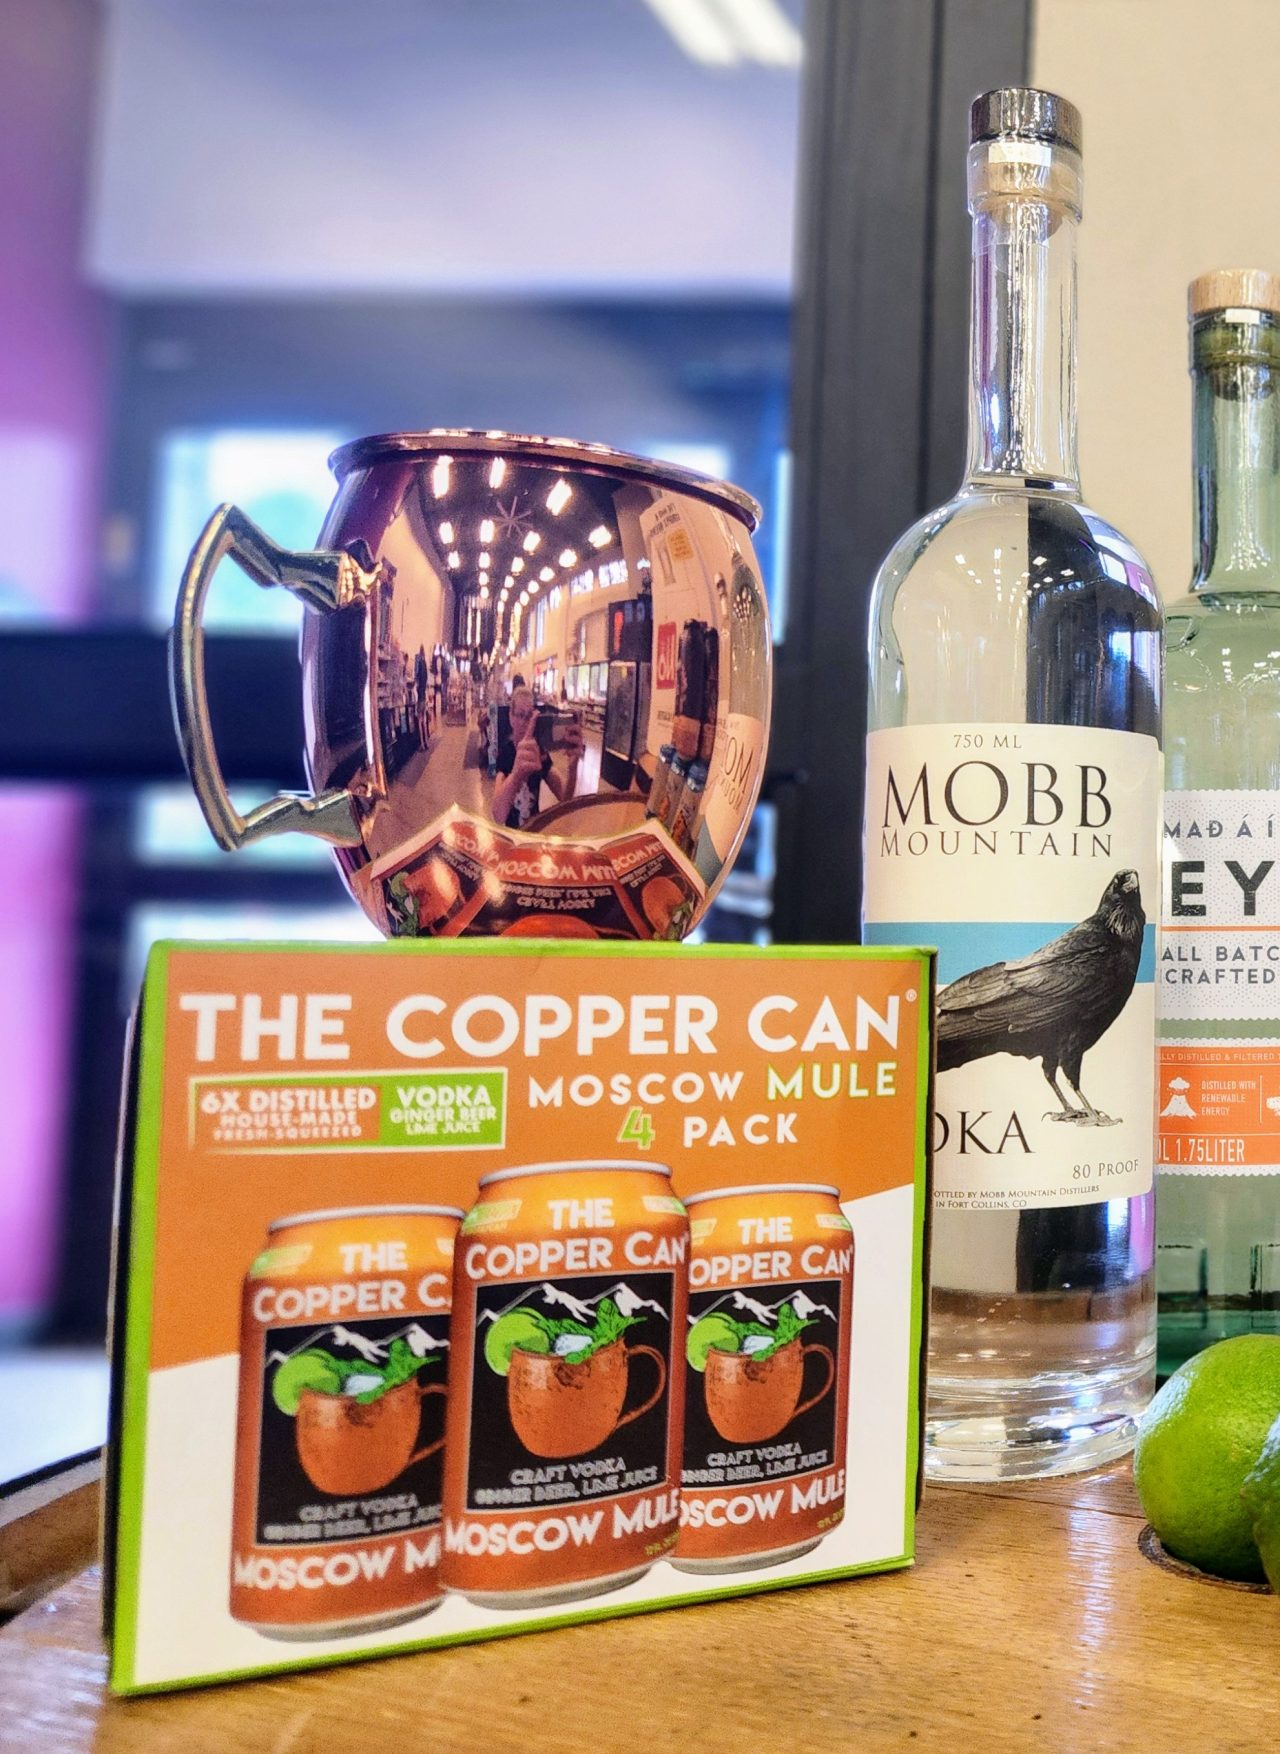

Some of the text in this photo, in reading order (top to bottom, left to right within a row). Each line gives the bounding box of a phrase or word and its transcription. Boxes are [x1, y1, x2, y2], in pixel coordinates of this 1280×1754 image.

[953, 734, 1022, 749] 750 ML
[881, 760, 1112, 829] MOBB
[1164, 820, 1223, 839] MAÐ
[880, 829, 1112, 858] MOUNTAIN
[1162, 946, 1202, 962] ALL
[1165, 968, 1276, 984] CRAFTED
[180, 993, 353, 1061] THE
[386, 993, 719, 1059] COPPER
[1176, 1052, 1220, 1061] DISTILLED
[1233, 1052, 1274, 1061] FILTERED
[396, 1084, 493, 1109] VODKA
[528, 1061, 898, 1108] MOSCOW MULE
[1200, 1080, 1257, 1090] DISTILLED WITH
[1200, 1093, 1246, 1103] RENEWABLE
[201, 1087, 378, 1114] 6X DISTILLED
[459, 1103, 498, 1121] BEER
[1200, 1106, 1230, 1116] ENERGY
[616, 1105, 799, 1151] 4 PACK
[1072, 1159, 1139, 1179] 80 PROOF
[934, 1190, 965, 1199] OTTLED
[979, 1190, 1006, 1199] MOBB
[1008, 1188, 1057, 1199] MOUNTAIN
[1059, 1185, 1100, 1196] DISTILLERS
[947, 1200, 968, 1208] FORT
[1012, 1200, 1027, 1208] CO
[546, 1198, 616, 1231] THE
[737, 1216, 794, 1246] THE
[338, 1240, 408, 1275] THE
[465, 1237, 614, 1281] COPPER
[689, 1249, 793, 1287] OPPER
[252, 1279, 407, 1323] COPPER
[707, 1441, 802, 1468] CRAFT VODKA
[509, 1456, 627, 1487] CRAFT VODKA
[445, 1510, 604, 1558] MOSCOW
[234, 1545, 396, 1591] MOSCOW
